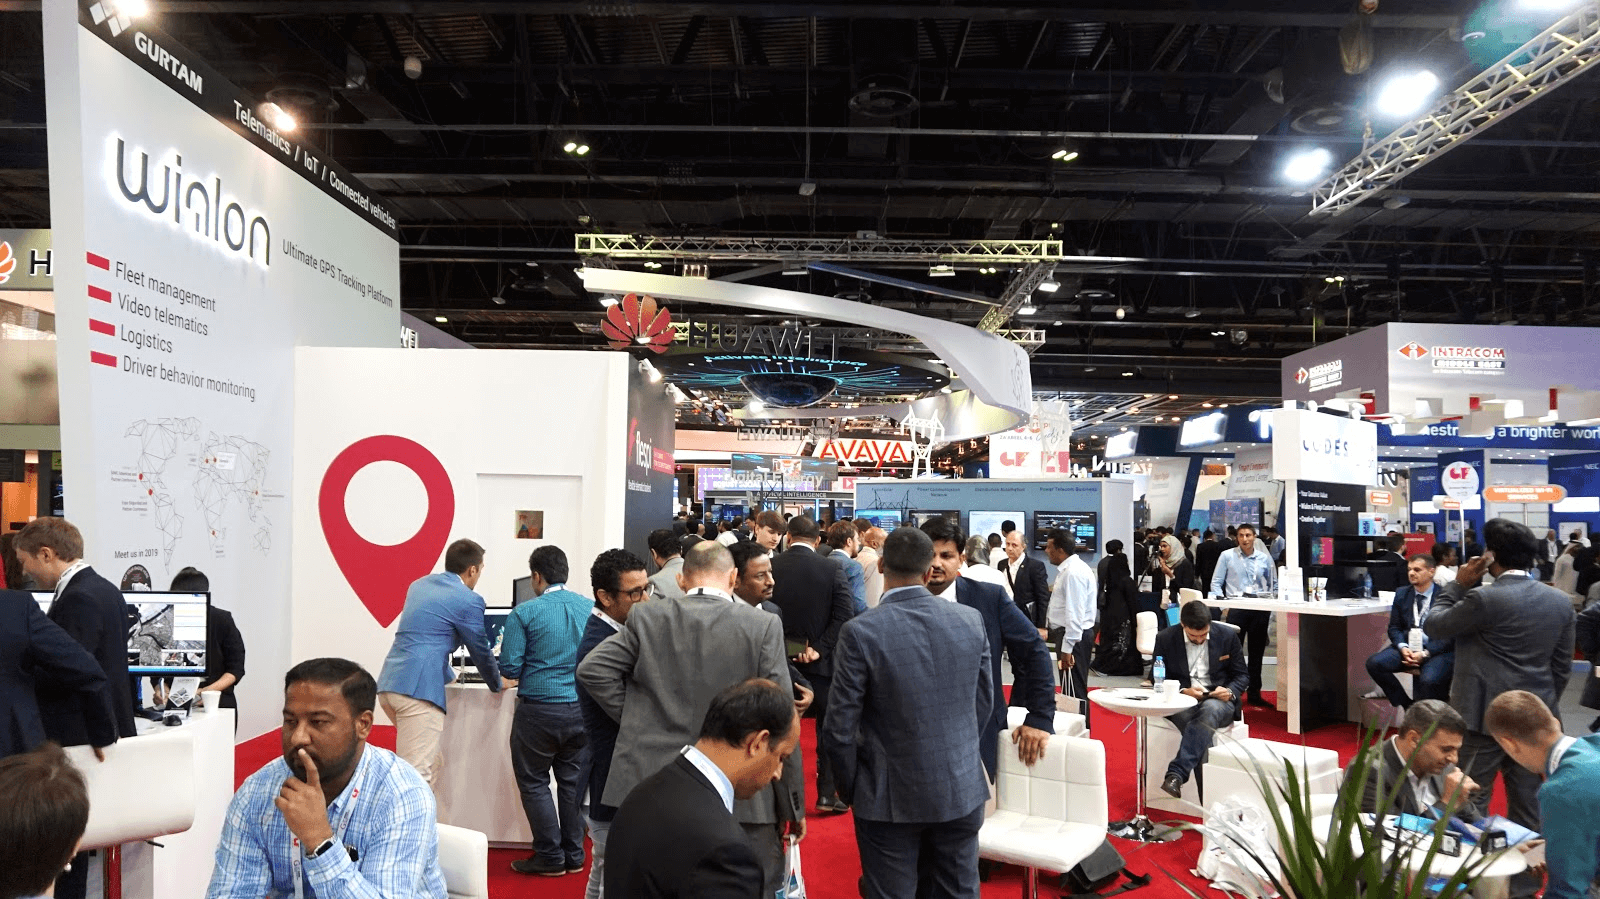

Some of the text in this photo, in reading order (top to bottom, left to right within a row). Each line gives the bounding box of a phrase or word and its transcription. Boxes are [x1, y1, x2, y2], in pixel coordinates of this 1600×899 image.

[134, 31, 203, 94] GURTAM
[234, 100, 291, 155] Telematics
[304, 152, 319, 174] IoT
[329, 173, 369, 211] Connected
[370, 200, 396, 230] vehicles
[115, 261, 216, 312] Fleet management
[283, 239, 393, 308] Ultimate GPS Tracking Platform
[118, 292, 208, 336] Video telematics
[121, 324, 173, 353] Logistics
[688, 318, 840, 361] HUAWEI
[1432, 347, 1506, 358] INTRACOM
[123, 355, 256, 402] Driver behavior monitoring
[819, 439, 908, 469] AVAYA
[1497, 427, 1506, 438] a
[1510, 426, 1567, 441] brighter
[1584, 462, 1600, 470] NEC
[114, 548, 158, 559] Meet us in 2019
